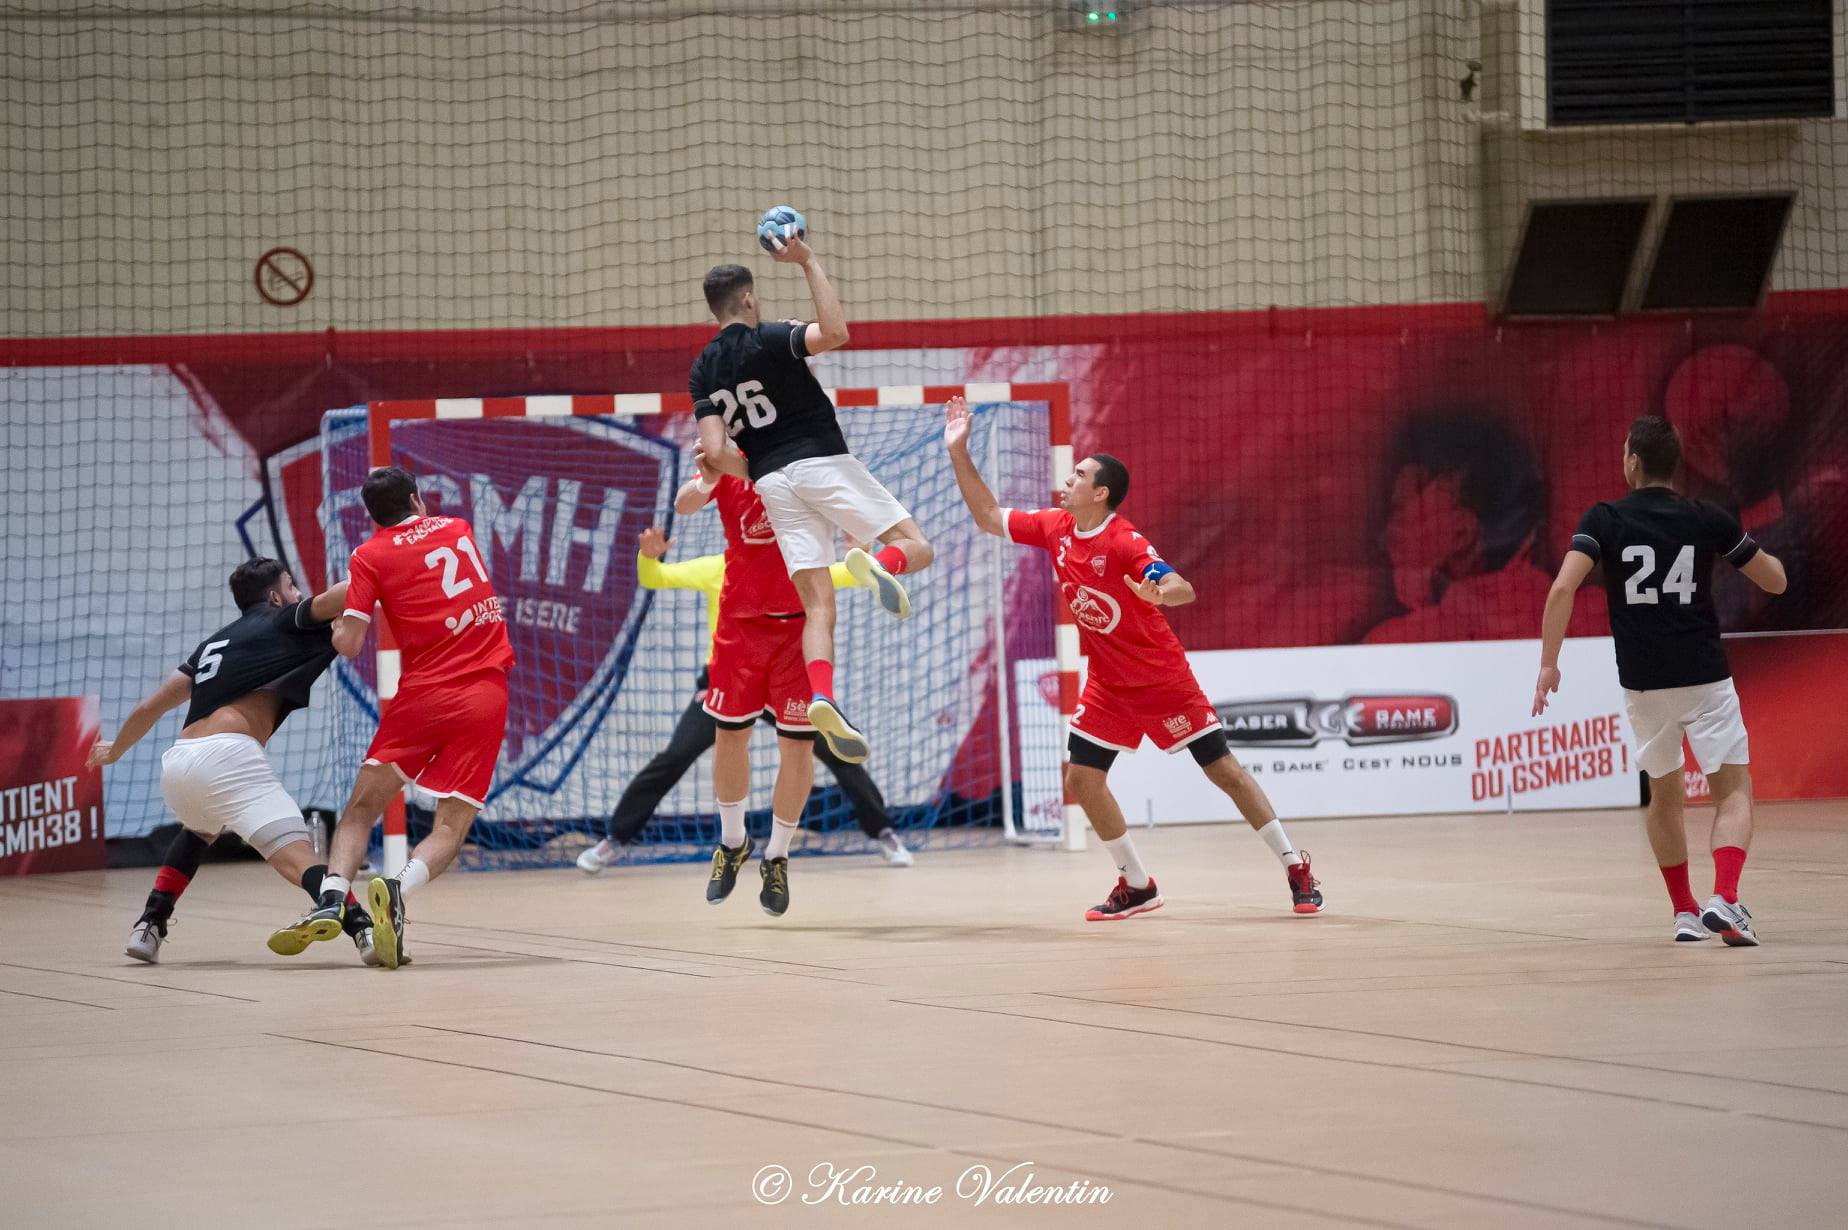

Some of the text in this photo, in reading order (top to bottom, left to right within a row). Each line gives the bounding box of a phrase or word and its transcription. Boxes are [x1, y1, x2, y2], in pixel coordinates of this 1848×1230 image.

[709, 379, 777, 437] 26
[424, 535, 489, 600] 21
[1621, 545, 1697, 605] 24
[195, 639, 230, 684] 5
[1070, 703, 1086, 725] 2
[1475, 713, 1622, 770] PARTENAIRE
[1402, 753, 1463, 769] NOUS
[1471, 768, 1505, 802] DU
[1512, 747, 1614, 794] GSMH38
